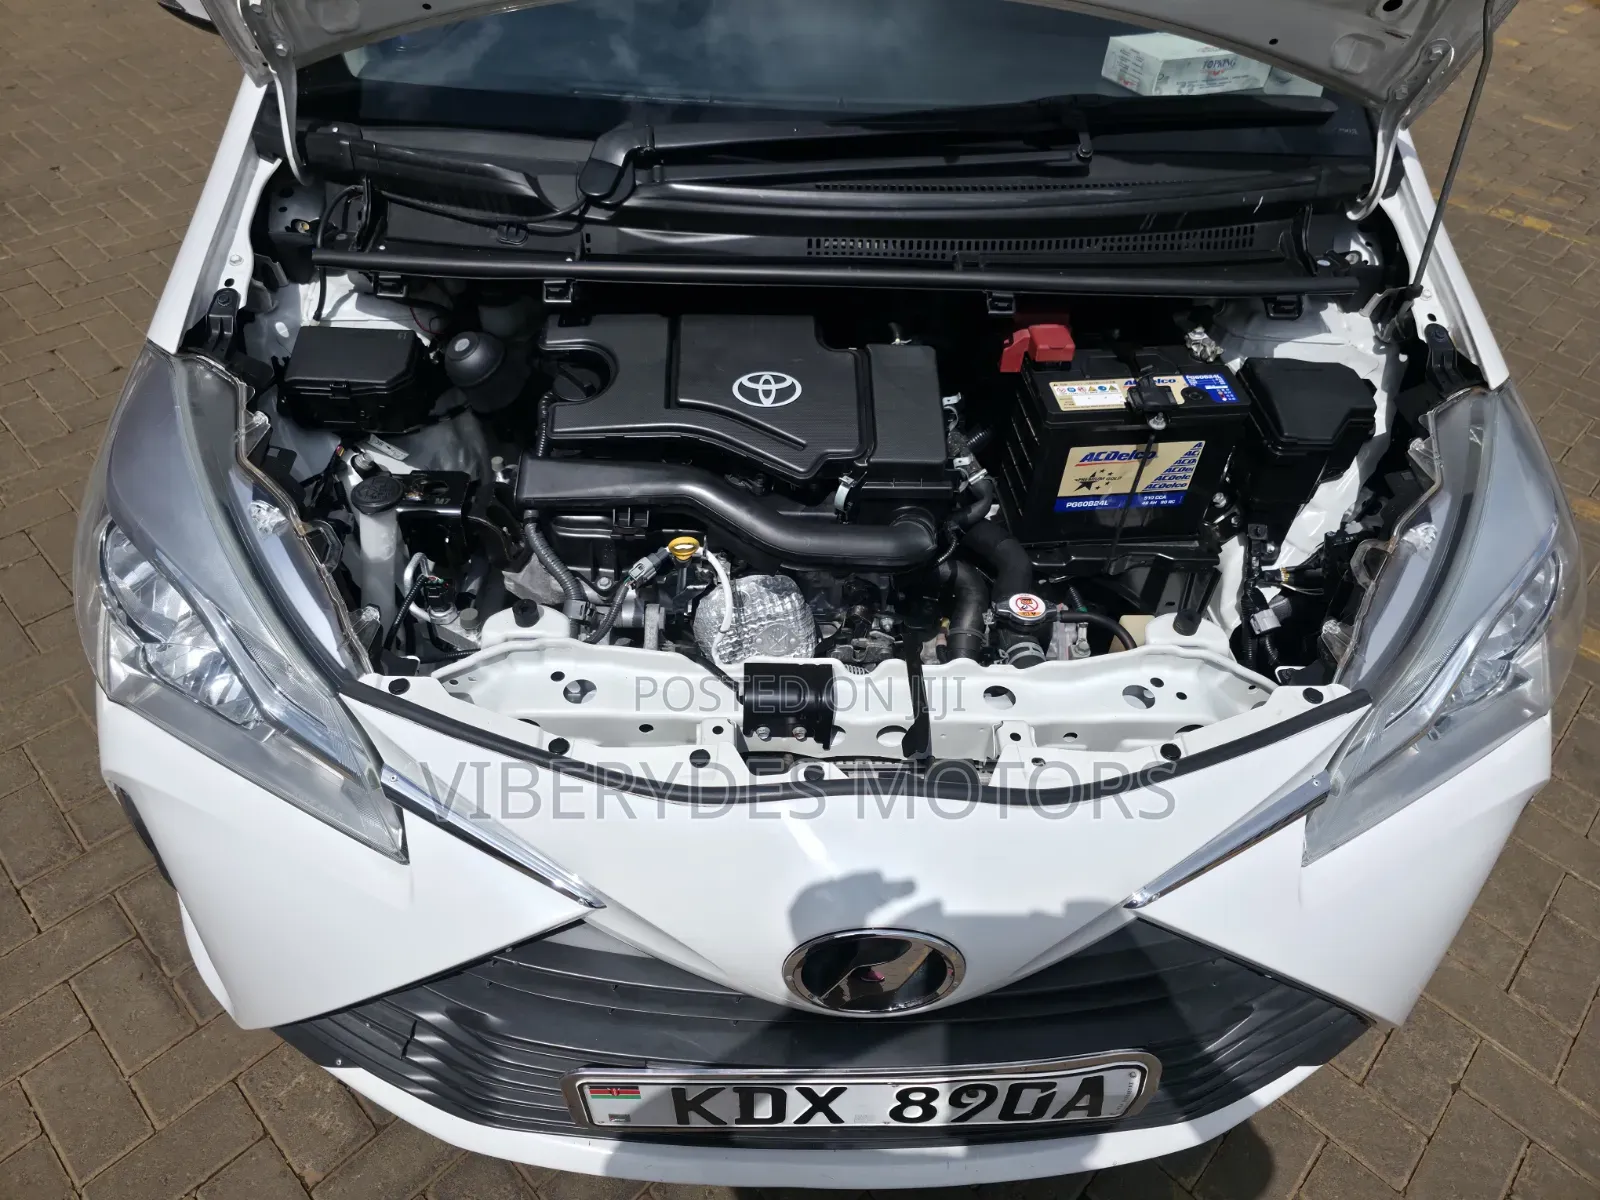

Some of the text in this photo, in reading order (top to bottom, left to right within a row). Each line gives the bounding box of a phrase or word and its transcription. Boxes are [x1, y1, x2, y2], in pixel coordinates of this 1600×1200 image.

[1080, 450, 1157, 463] ACDelco
[1143, 482, 1188, 490] ACDelco
[1066, 500, 1109, 508] PG60B24L
[670, 1086, 848, 1126] KDX
[888, 1075, 1105, 1124] 890A
